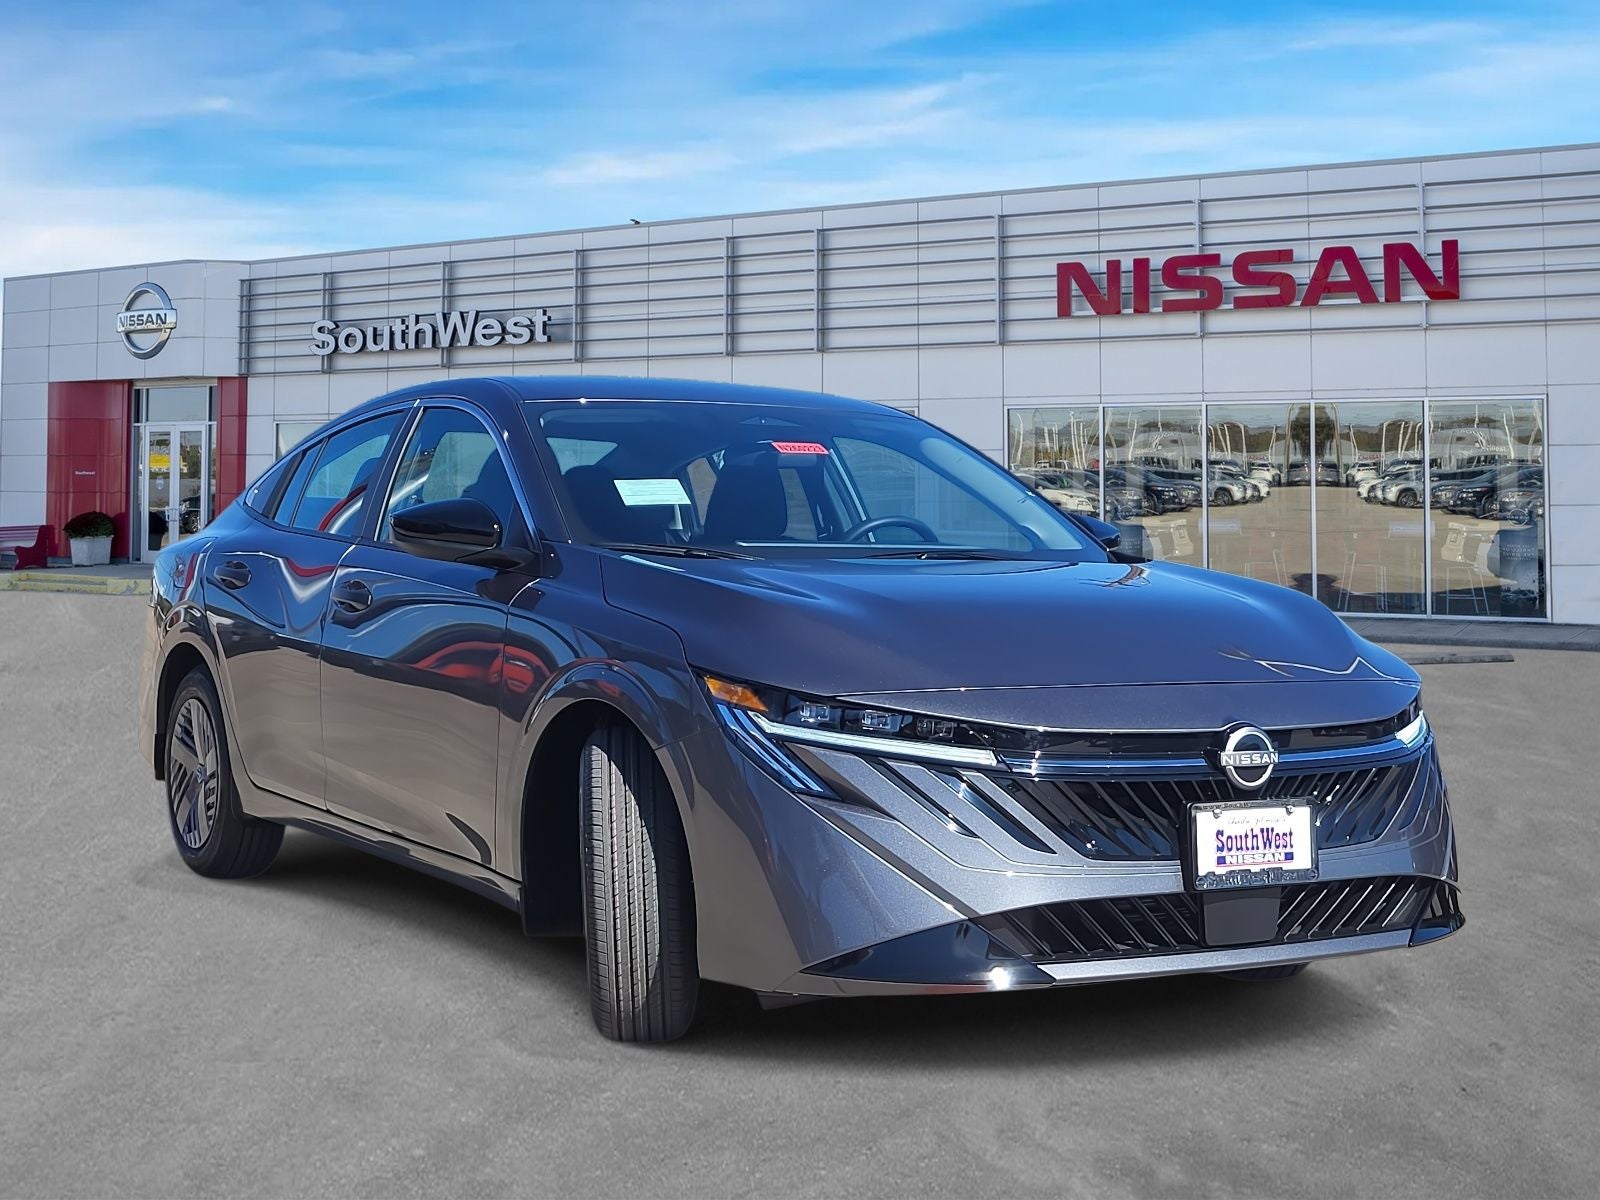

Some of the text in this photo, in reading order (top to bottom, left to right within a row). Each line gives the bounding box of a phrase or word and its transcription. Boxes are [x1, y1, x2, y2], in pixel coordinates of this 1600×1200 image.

[1057, 239, 1460, 319] NISSAN
[119, 312, 167, 328] NISSAN
[310, 308, 551, 356] SouthWest
[1222, 752, 1279, 765] NISSAN
[1215, 827, 1293, 852] SouthWest
[1225, 852, 1286, 865] NISSAN
